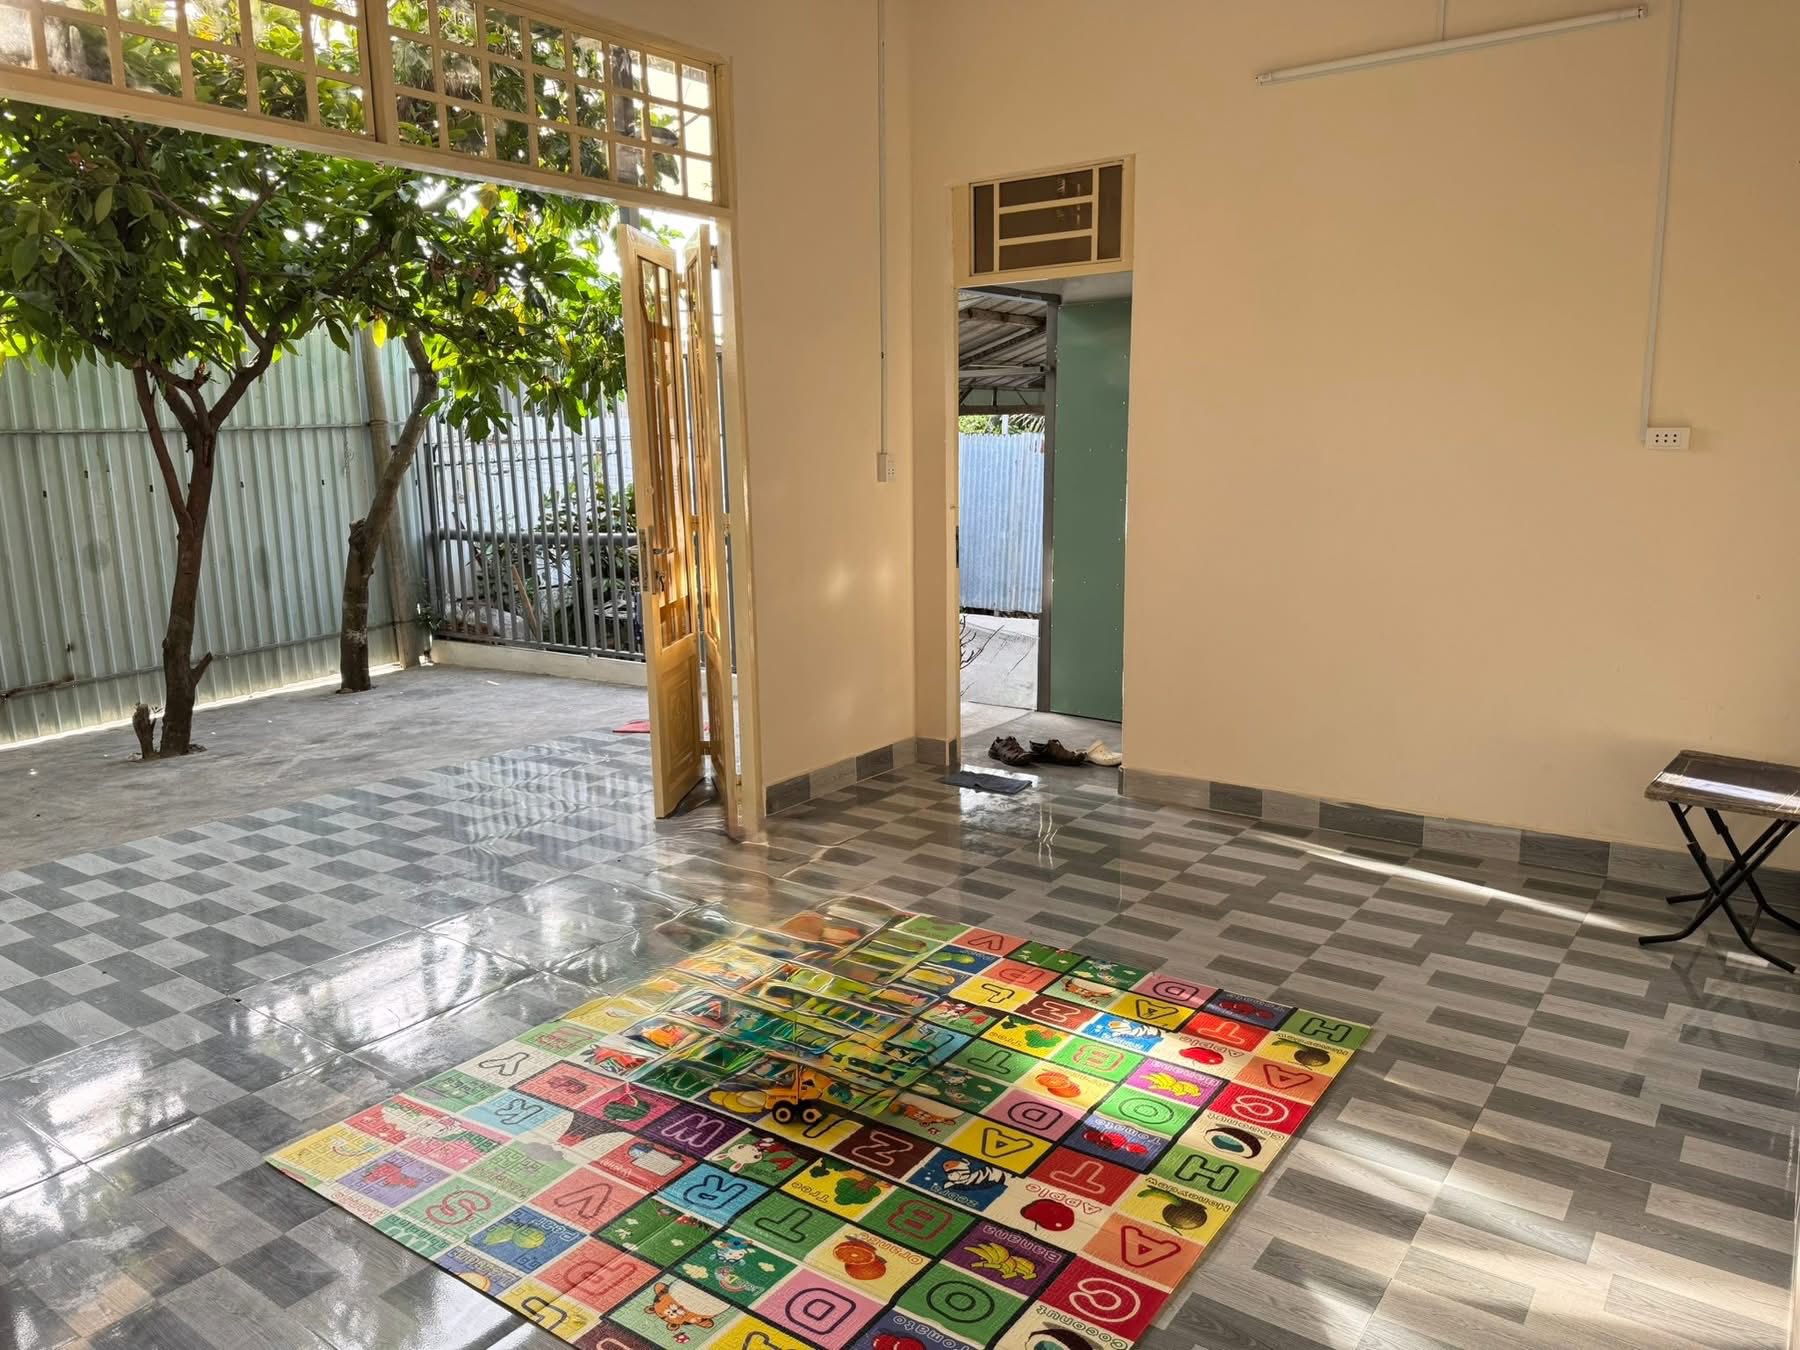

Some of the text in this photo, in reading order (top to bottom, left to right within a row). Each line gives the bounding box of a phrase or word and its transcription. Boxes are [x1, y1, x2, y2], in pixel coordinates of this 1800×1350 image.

[1153, 980, 1199, 1001] D
[1136, 999, 1179, 1020] A
[1200, 1021, 1245, 1045] T
[1300, 1017, 1352, 1043] H
[1072, 1044, 1124, 1072] B
[1179, 1035, 1245, 1058] Apple
[478, 1051, 530, 1076] Y
[968, 1050, 1012, 1075] T
[1263, 1063, 1313, 1089] A
[494, 1099, 544, 1125] K
[1008, 1101, 1063, 1130] D
[1232, 1095, 1289, 1123] C
[1095, 1118, 1161, 1145] Tomato
[1206, 1112, 1286, 1142] Coconut
[852, 1130, 914, 1167] Z
[981, 1127, 1034, 1158] A
[1050, 1161, 1105, 1194] T
[1175, 1154, 1240, 1193] H
[554, 1183, 613, 1219] V
[683, 1174, 748, 1210] R
[790, 1181, 828, 1204] Tree
[1026, 1183, 1102, 1215] Apple
[1144, 1177, 1231, 1213] Honeydew
[529, 1216, 580, 1243] Pear
[755, 1207, 812, 1243] T
[887, 1199, 953, 1240] B
[983, 1224, 1063, 1265] Banana
[1121, 1225, 1181, 1268] A
[563, 1260, 638, 1296] P
[785, 1288, 857, 1335] D
[1069, 1277, 1141, 1323] C
[1036, 1305, 1129, 1350] Coconut
